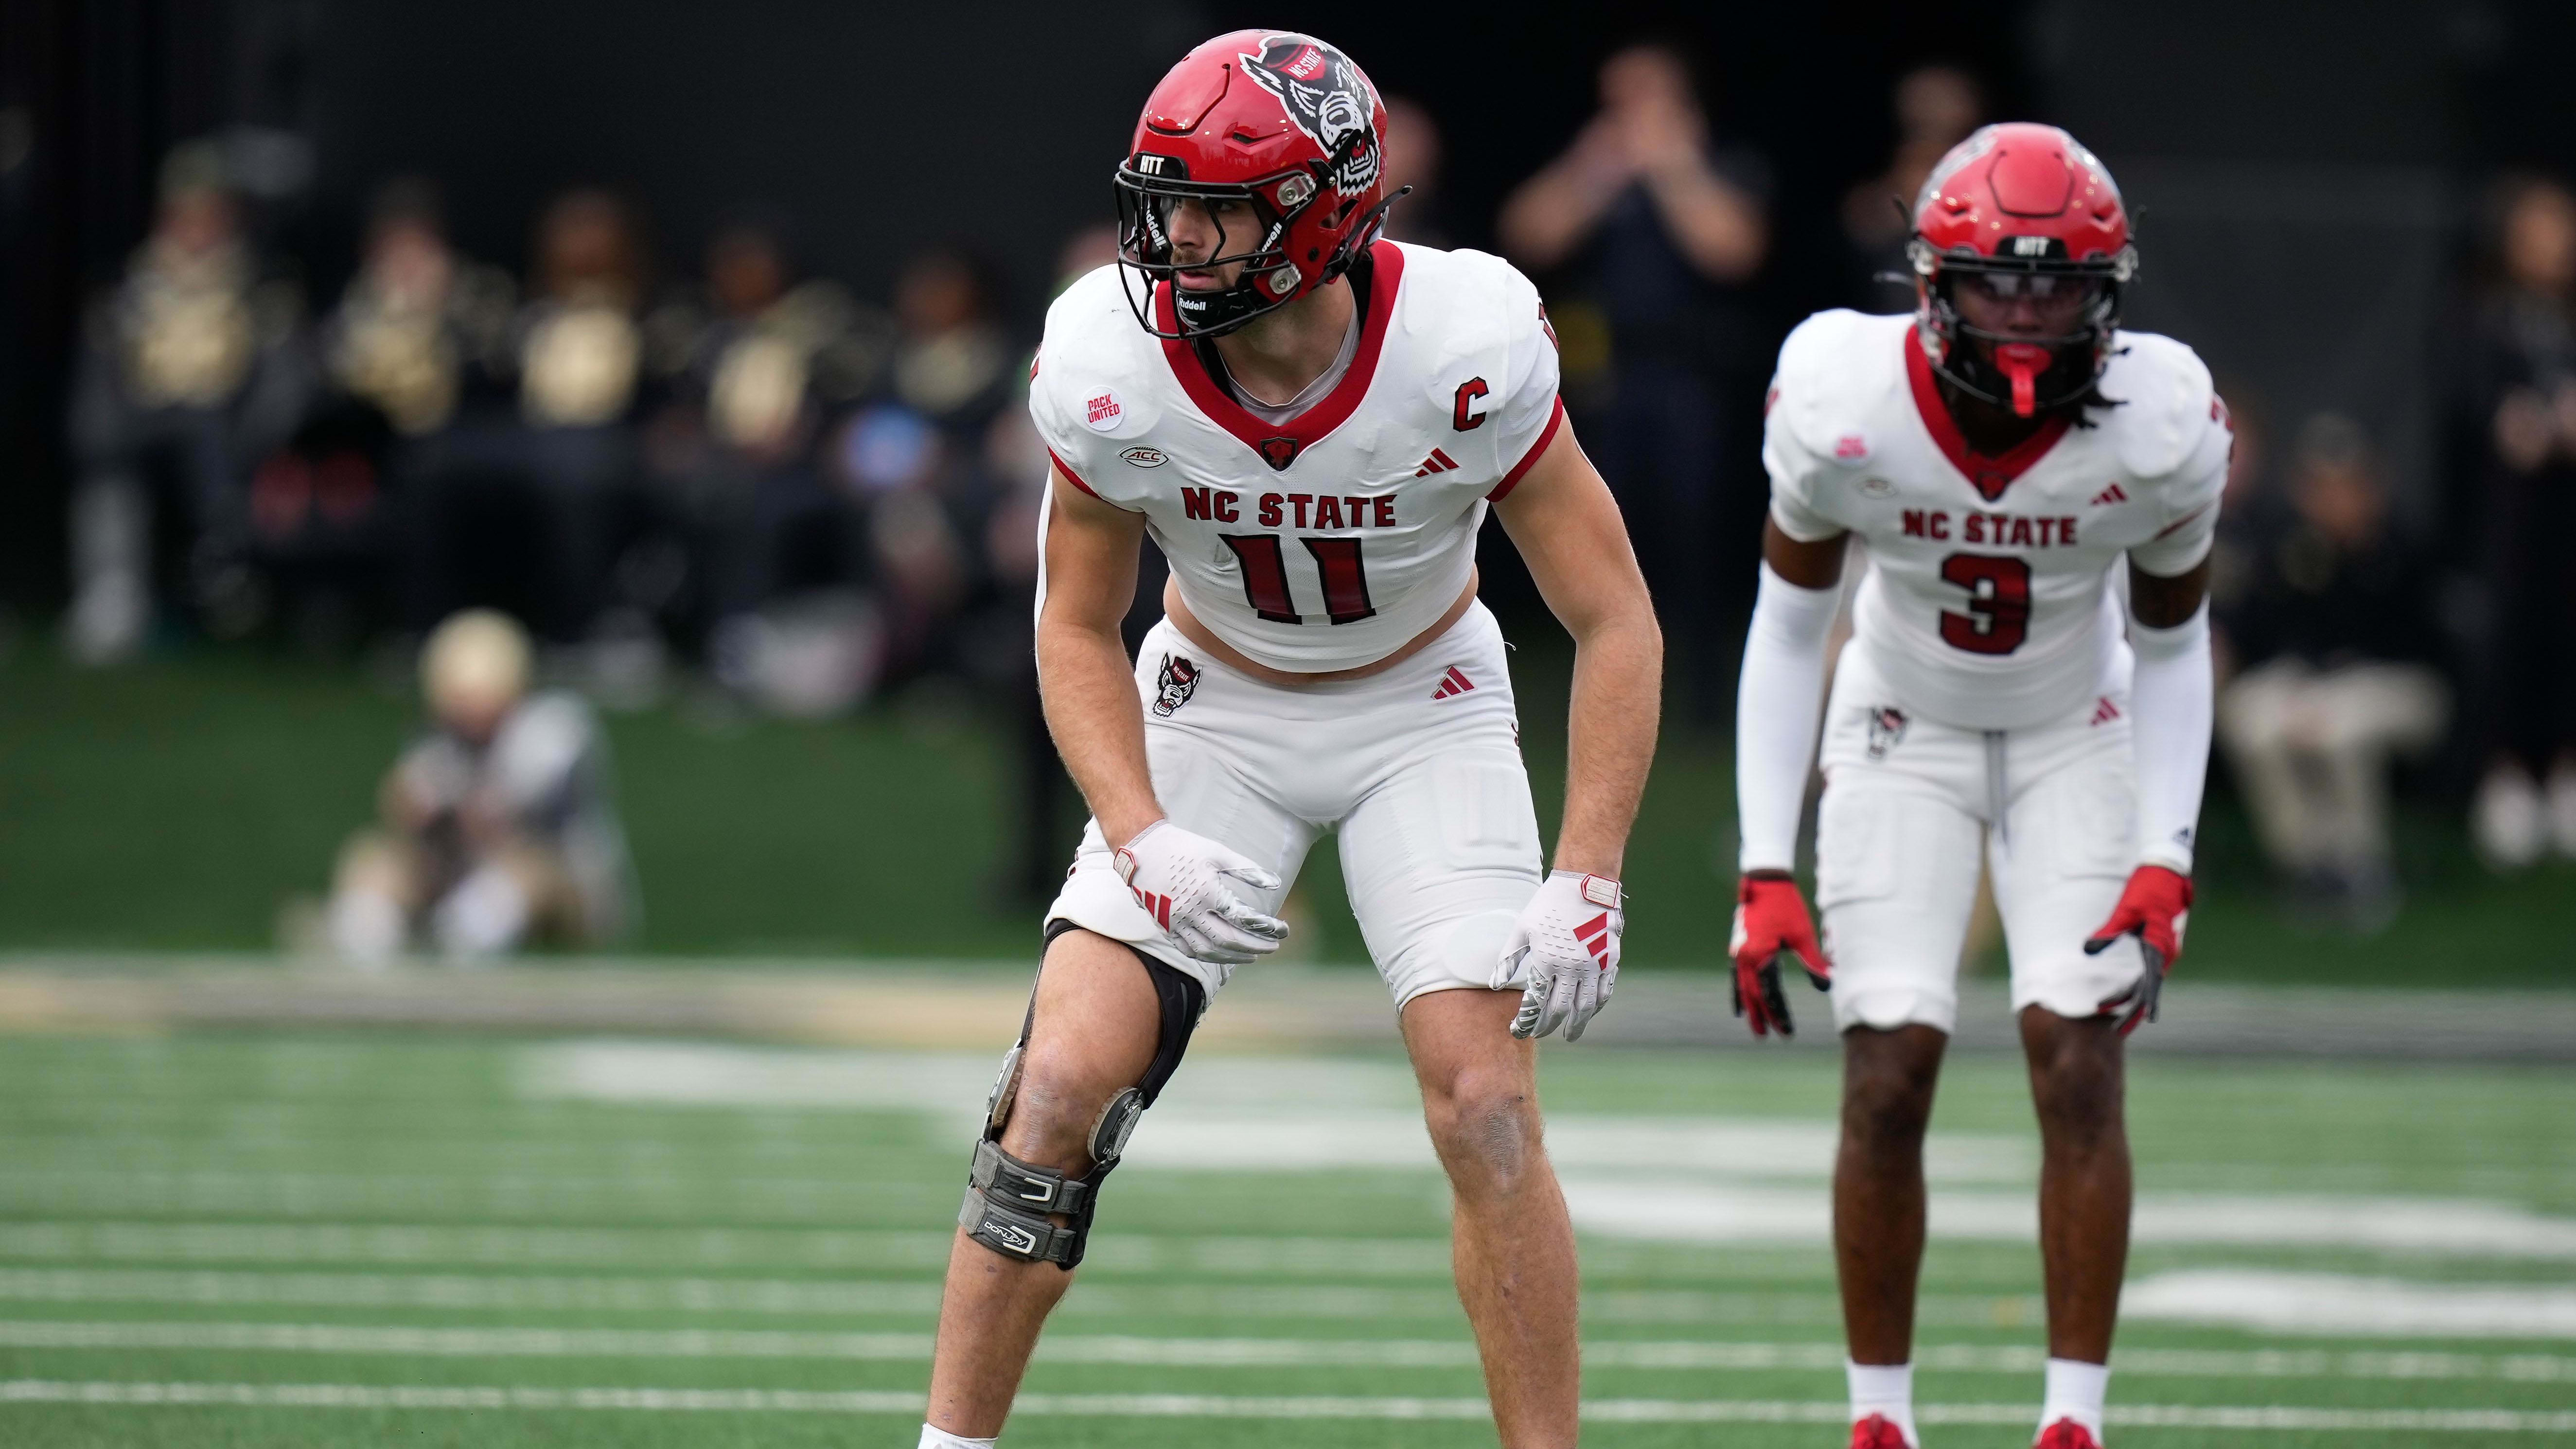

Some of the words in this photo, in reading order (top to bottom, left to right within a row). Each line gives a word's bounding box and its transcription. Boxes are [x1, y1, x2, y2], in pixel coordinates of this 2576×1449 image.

[1288, 64, 1309, 78] NC
[1299, 47, 1322, 71] STATE
[1140, 155, 1164, 175] HTT
[1179, 297, 1206, 311] Riddell
[1088, 394, 1112, 411] PACK
[1088, 404, 1120, 423] UNITED
[1453, 376, 1489, 432] C
[1128, 451, 1162, 460] ACC
[1181, 487, 1239, 523] NC
[1259, 493, 1397, 529] STATE
[1903, 510, 1948, 541] NC
[1965, 513, 2078, 548] STATE
[1217, 533, 1376, 626] 11
[1940, 552, 2033, 655] 3
[1173, 665, 1180, 673] NC
[1177, 671, 1189, 681] STATE
[984, 1221, 1027, 1245] DONJOY
